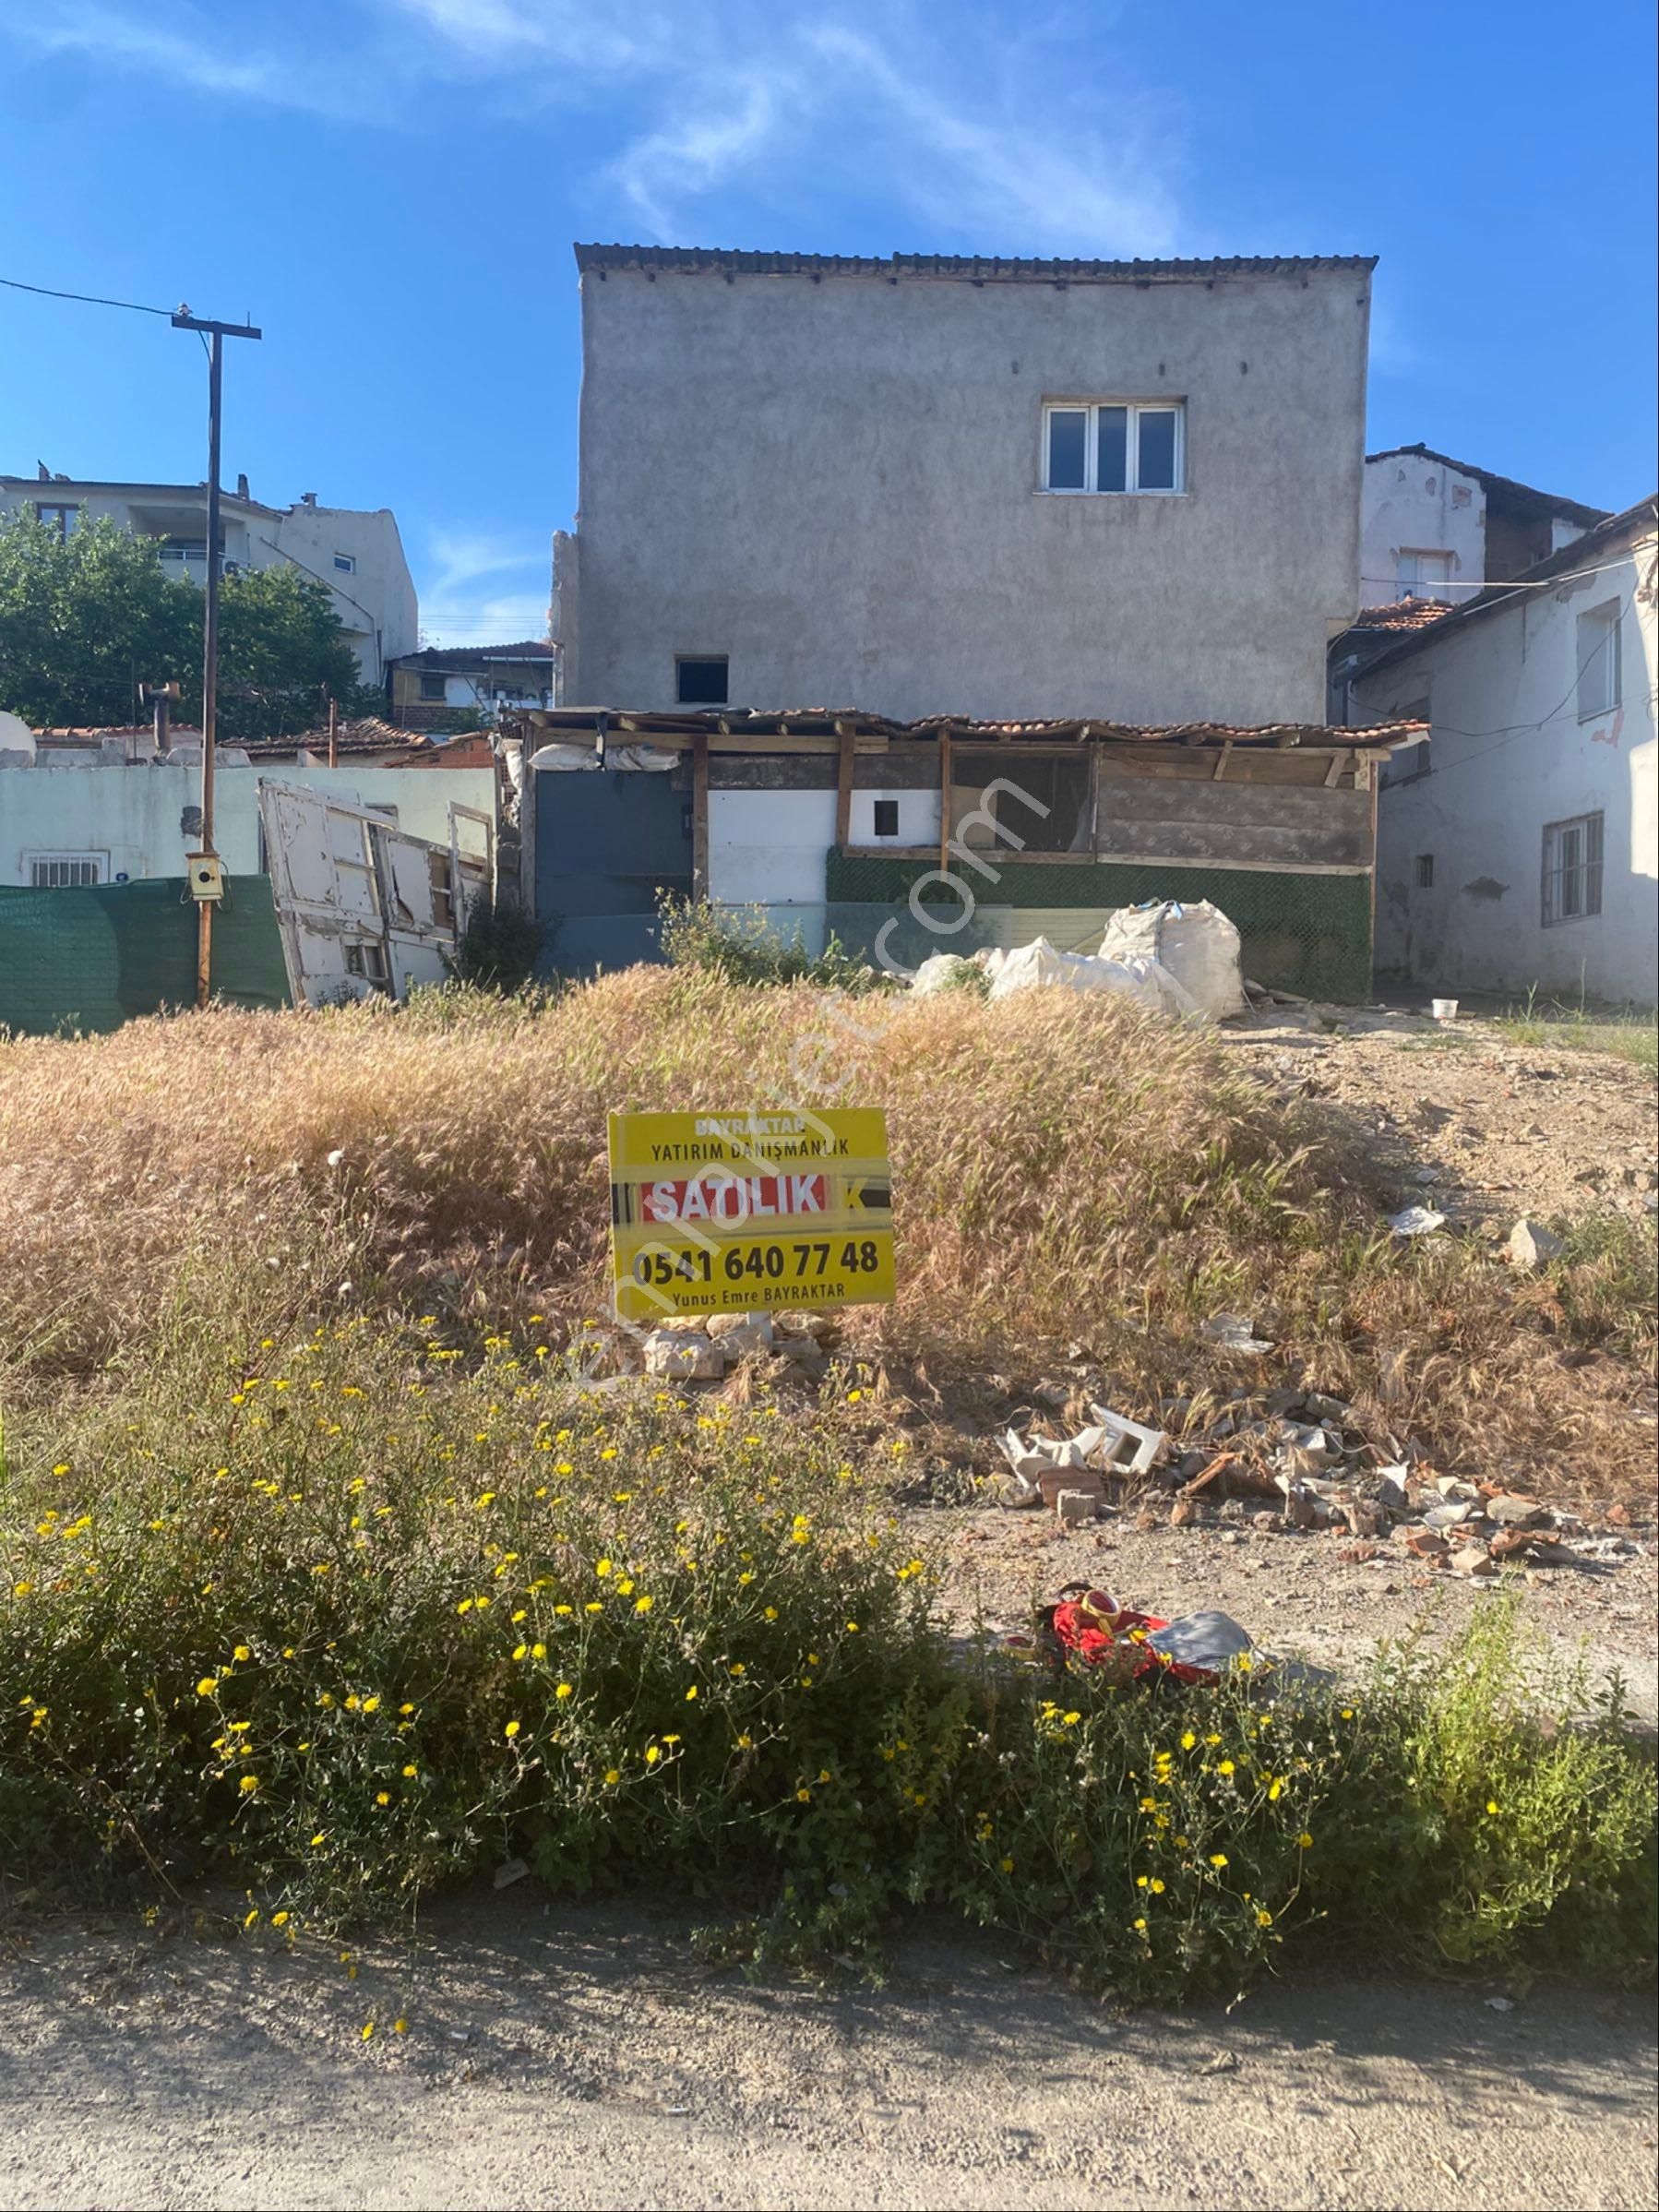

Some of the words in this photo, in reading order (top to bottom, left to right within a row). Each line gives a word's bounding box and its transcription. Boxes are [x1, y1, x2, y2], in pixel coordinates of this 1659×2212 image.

[695, 1116, 806, 1136] BAYRAKTAR
[651, 1142, 723, 1161] YATIRIM
[732, 1138, 849, 1161] DANIŞMANLIK
[651, 1174, 822, 1223] SATILIK
[633, 1250, 711, 1285] 0541
[724, 1246, 784, 1281] 640
[794, 1244, 830, 1276] 77
[841, 1241, 877, 1273] 48
[673, 1292, 717, 1308] Yunus
[722, 1289, 758, 1304] Emre
[764, 1283, 845, 1301] BAYRAKTAR
